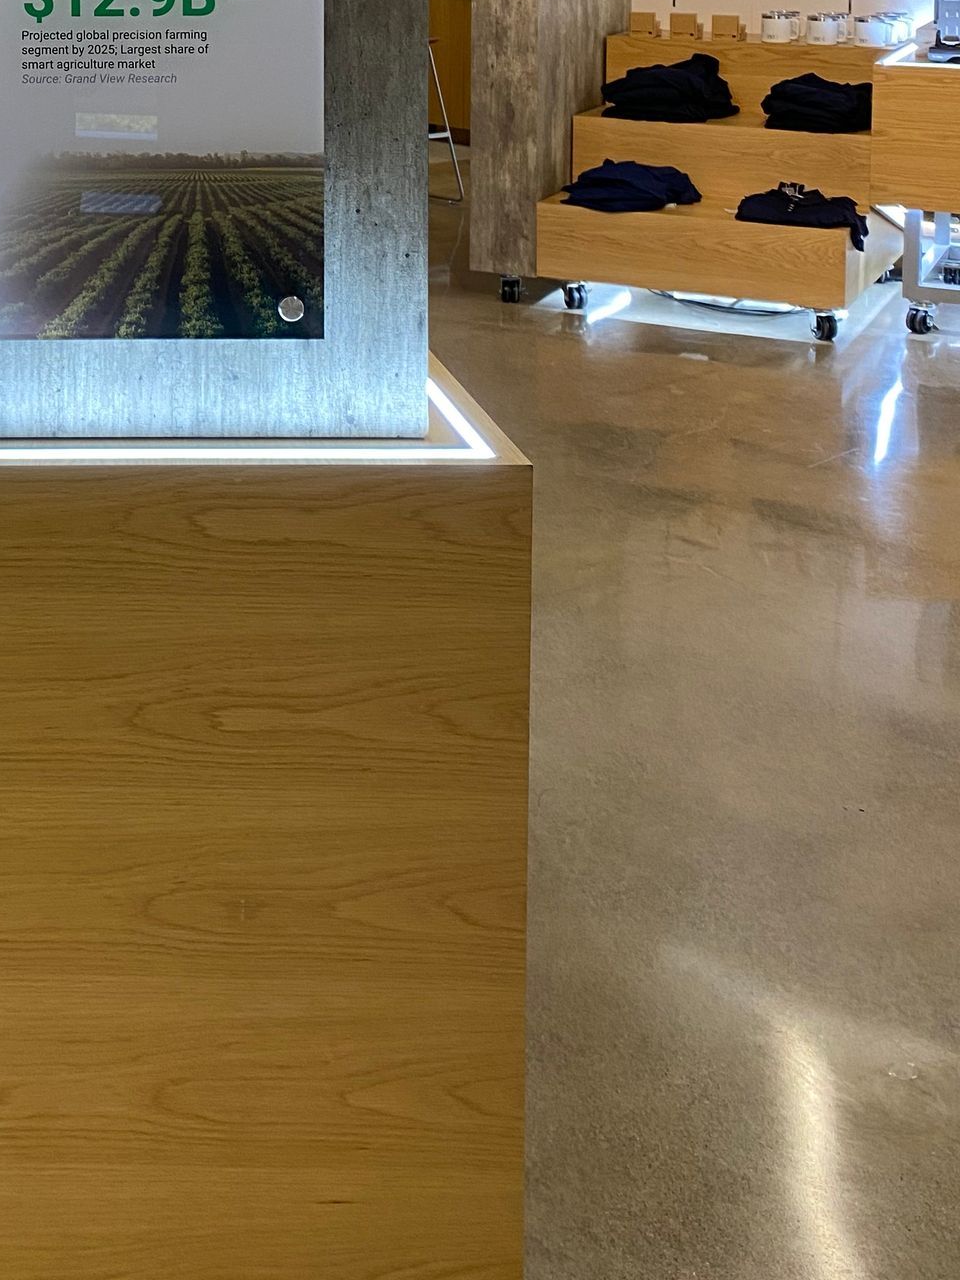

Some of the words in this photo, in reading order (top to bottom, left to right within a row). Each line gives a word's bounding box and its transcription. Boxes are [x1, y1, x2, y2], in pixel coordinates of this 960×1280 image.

[21, 29, 74, 43] Projected
[75, 29, 110, 43] global
[112, 29, 162, 43] precision
[165, 28, 208, 42] farming
[21, 44, 70, 58] segment
[71, 44, 85, 58] by
[87, 44, 118, 56] 2025;
[120, 44, 162, 57] Largest
[164, 43, 195, 55] share
[197, 43, 210, 55] of
[21, 59, 54, 70] smart
[56, 58, 115, 72] agriculture
[117, 58, 156, 69] market
[21, 73, 62, 85] Source:
[64, 72, 97, 84] Grand
[99, 73, 126, 84] View
[127, 72, 178, 84] Research
